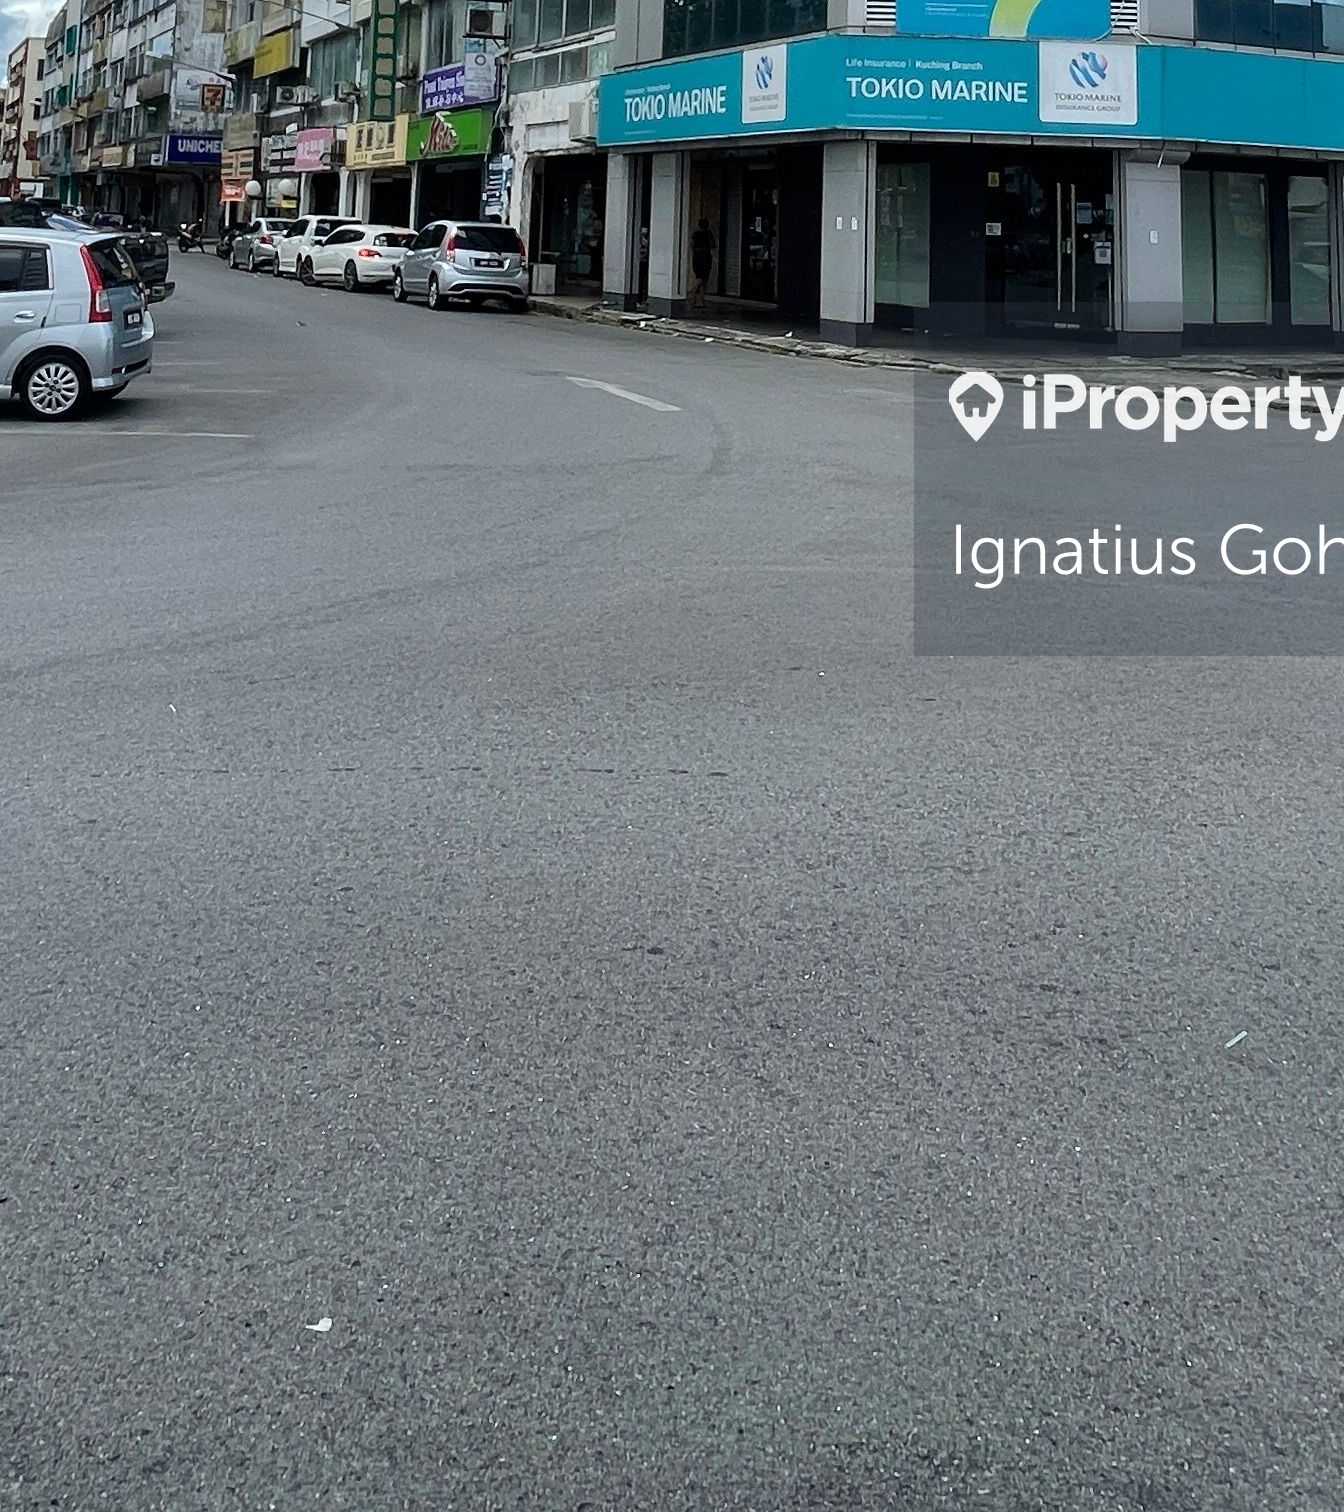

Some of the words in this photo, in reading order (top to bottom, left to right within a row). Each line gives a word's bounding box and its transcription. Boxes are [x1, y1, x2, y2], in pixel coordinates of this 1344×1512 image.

[846, 58, 863, 67] Life
[864, 58, 907, 69] Insurance
[915, 60, 951, 72] Kuching
[846, 77, 924, 100] TOKIO
[931, 79, 1028, 104] MARINE
[1055, 92, 1084, 102] TOKIO
[1084, 93, 1122, 103] MARINE
[624, 93, 666, 122] TOKIO
[667, 85, 727, 119] MARINE
[177, 138, 221, 153] UNICHE
